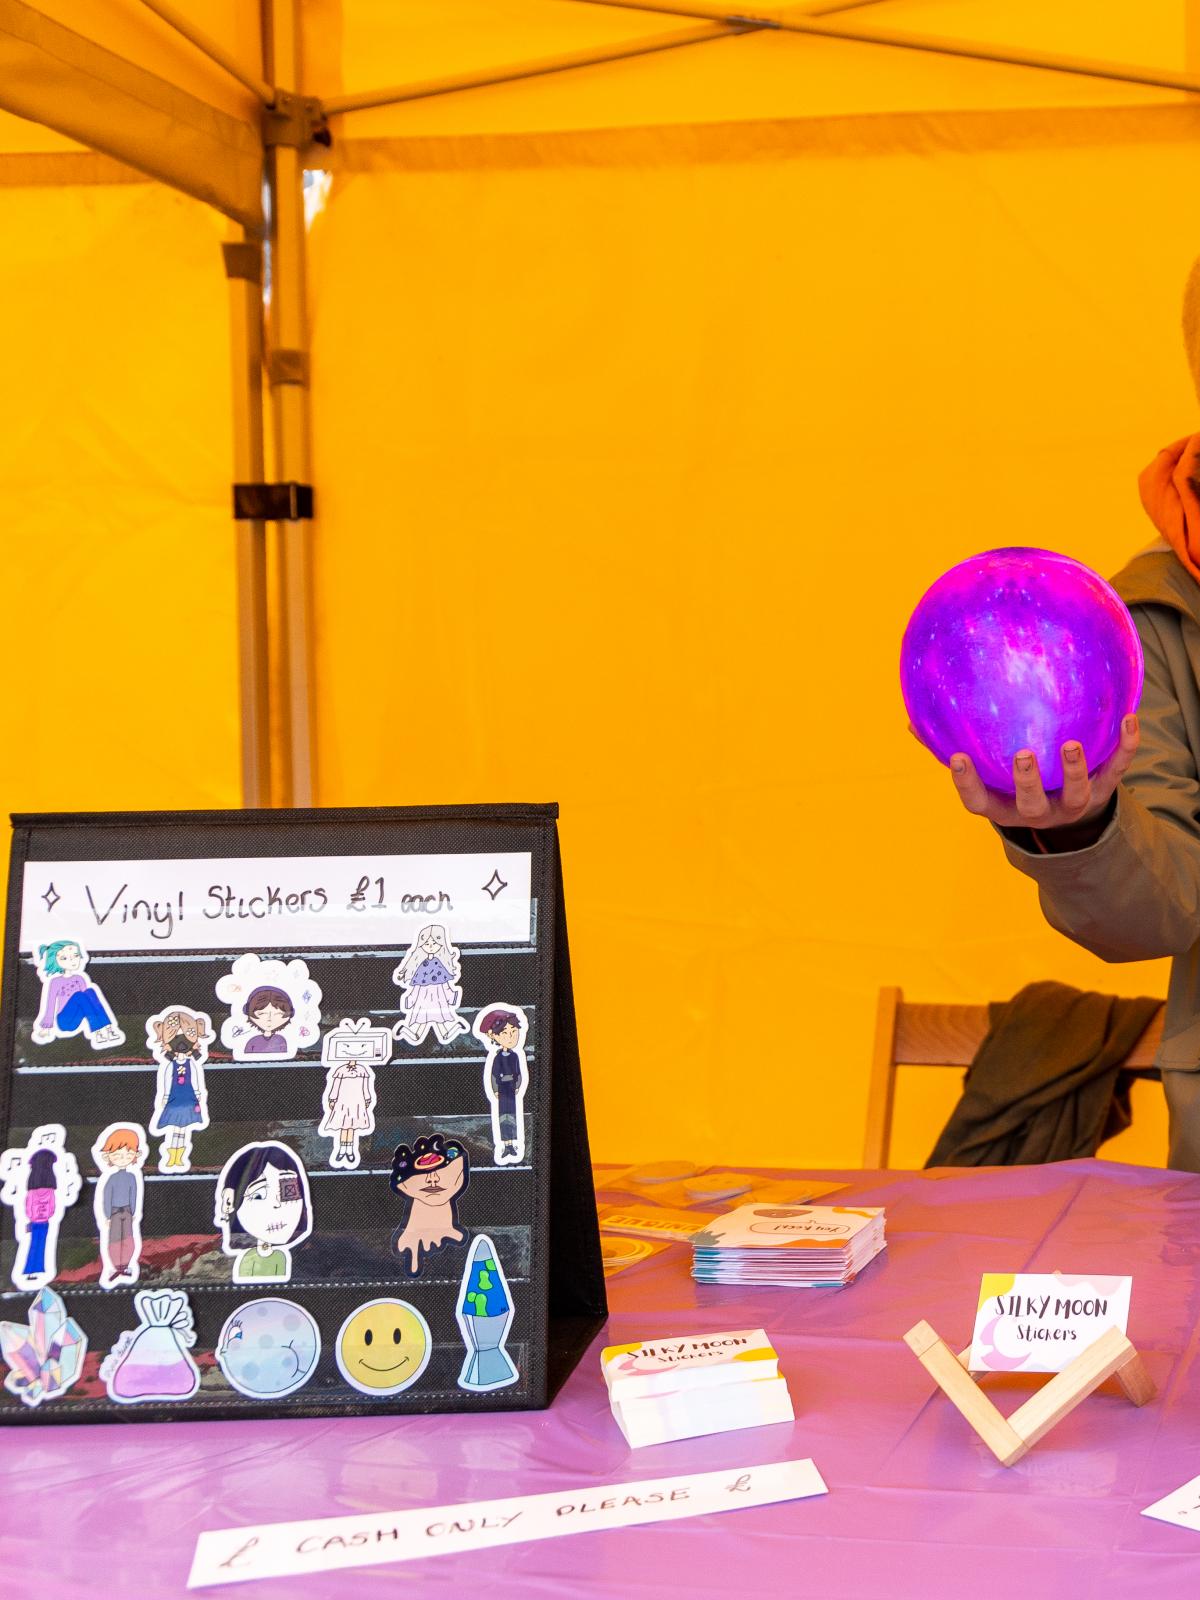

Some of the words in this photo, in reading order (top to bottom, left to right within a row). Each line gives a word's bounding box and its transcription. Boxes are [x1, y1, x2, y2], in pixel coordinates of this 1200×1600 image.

[85, 883, 185, 940] Vinyl
[202, 884, 328, 920] Stickers
[345, 876, 387, 913] £1
[400, 890, 454, 915] each
[995, 1294, 1050, 1320] SILKY
[1054, 1297, 1108, 1320] MOON
[692, 1338, 747, 1351] MOON
[1016, 1324, 1077, 1342] Stickers
[296, 1527, 399, 1555] CASH
[425, 1511, 523, 1537] ONLY
[555, 1486, 692, 1517] PLEASE
